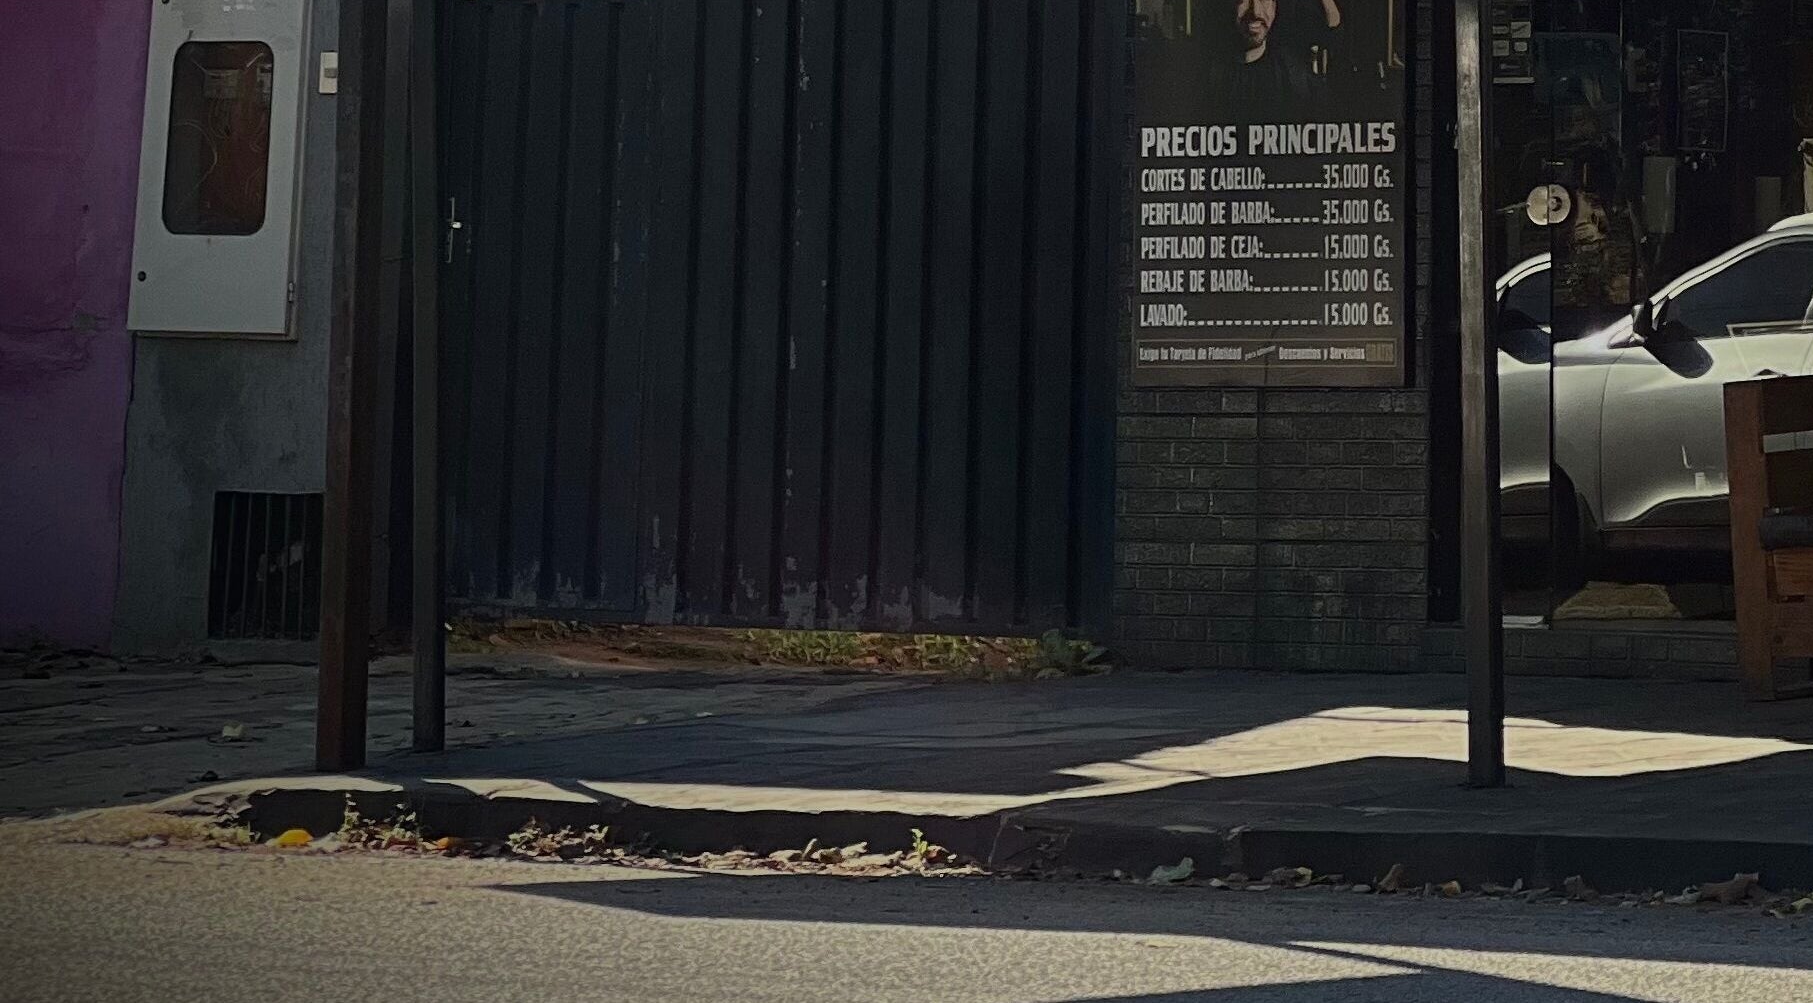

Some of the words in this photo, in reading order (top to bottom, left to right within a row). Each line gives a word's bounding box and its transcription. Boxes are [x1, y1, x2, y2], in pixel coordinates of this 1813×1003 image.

[1141, 125, 1237, 158] PRECIOS
[1248, 121, 1396, 156] PRINCIPALES
[1141, 168, 1185, 193] CORTES
[1190, 168, 1206, 191] DE
[1323, 163, 1369, 189] 35.000
[1374, 164, 1394, 188] Gs.
[1141, 201, 1206, 226] PERFILADO
[1211, 201, 1227, 225] DE
[1322, 199, 1369, 225] 35.000
[1374, 198, 1394, 223] Gs.
[1141, 235, 1206, 260] PERFILADO
[1210, 235, 1227, 259] DE
[1324, 234, 1369, 260] 15.000
[1373, 234, 1394, 258] Gs.
[1141, 269, 1185, 293] REBAJE
[1190, 269, 1206, 293] DE
[1324, 268, 1369, 292] 15.000
[1373, 268, 1394, 292] Gs.
[1324, 302, 1369, 326] 15.000
[1373, 301, 1394, 326] Gs.
